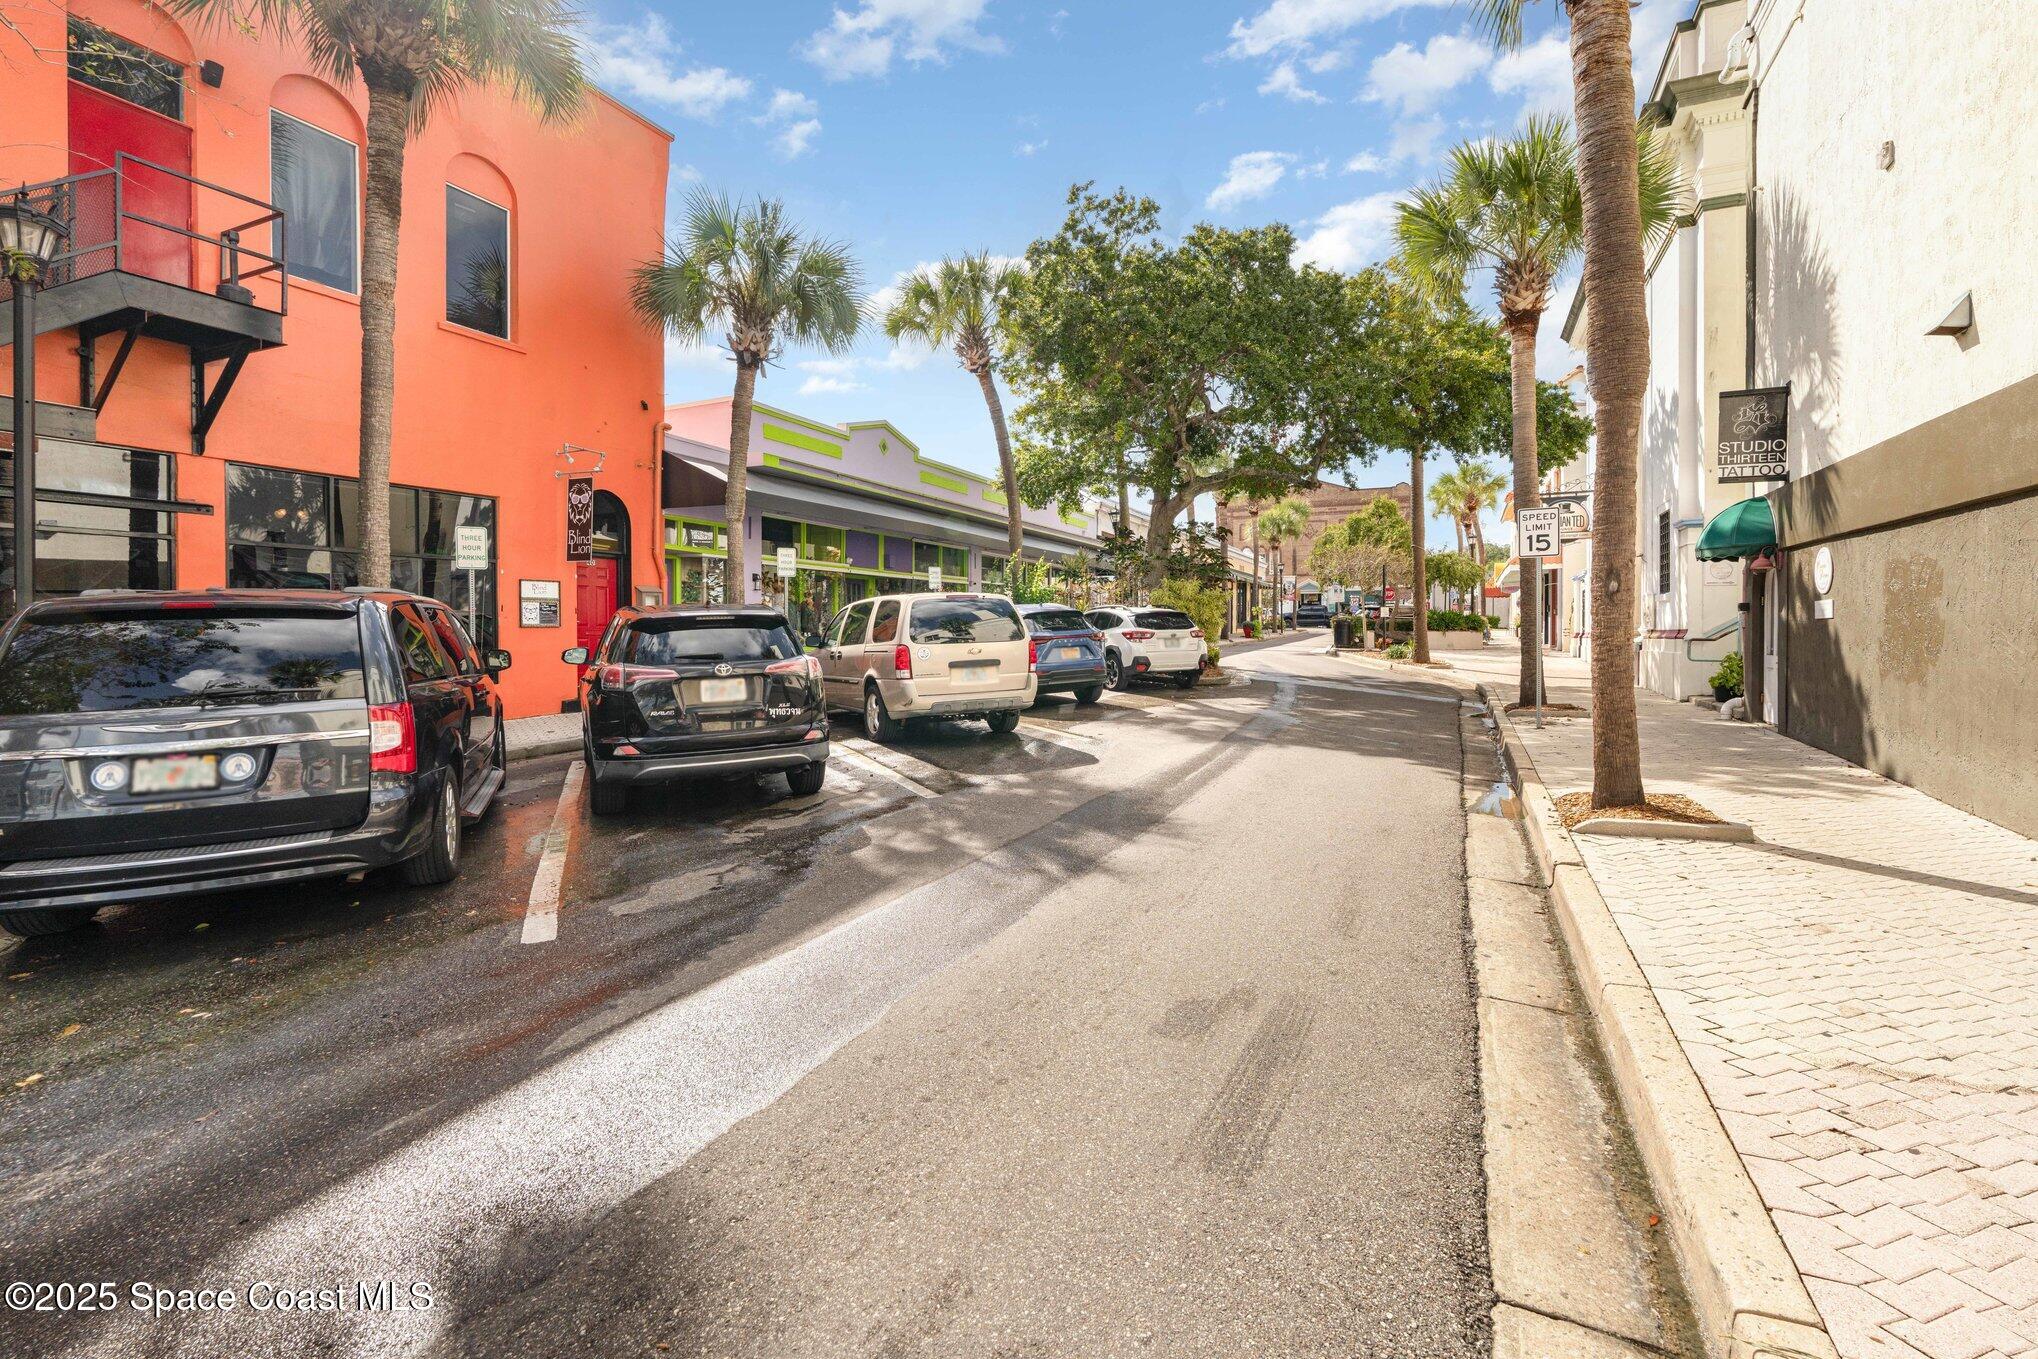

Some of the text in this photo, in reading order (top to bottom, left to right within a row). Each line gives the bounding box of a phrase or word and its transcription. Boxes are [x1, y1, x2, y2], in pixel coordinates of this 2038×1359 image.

[1719, 439, 1786, 454] STUDIO
[1719, 453, 1786, 464] THIRTEEN
[1719, 464, 1785, 477] TATTOO
[1522, 512, 1557, 521] SPEED
[1525, 523, 1552, 531] LIMIT
[568, 529, 591, 545] Blind
[1526, 534, 1551, 552] 15
[570, 540, 591, 554] Lion
